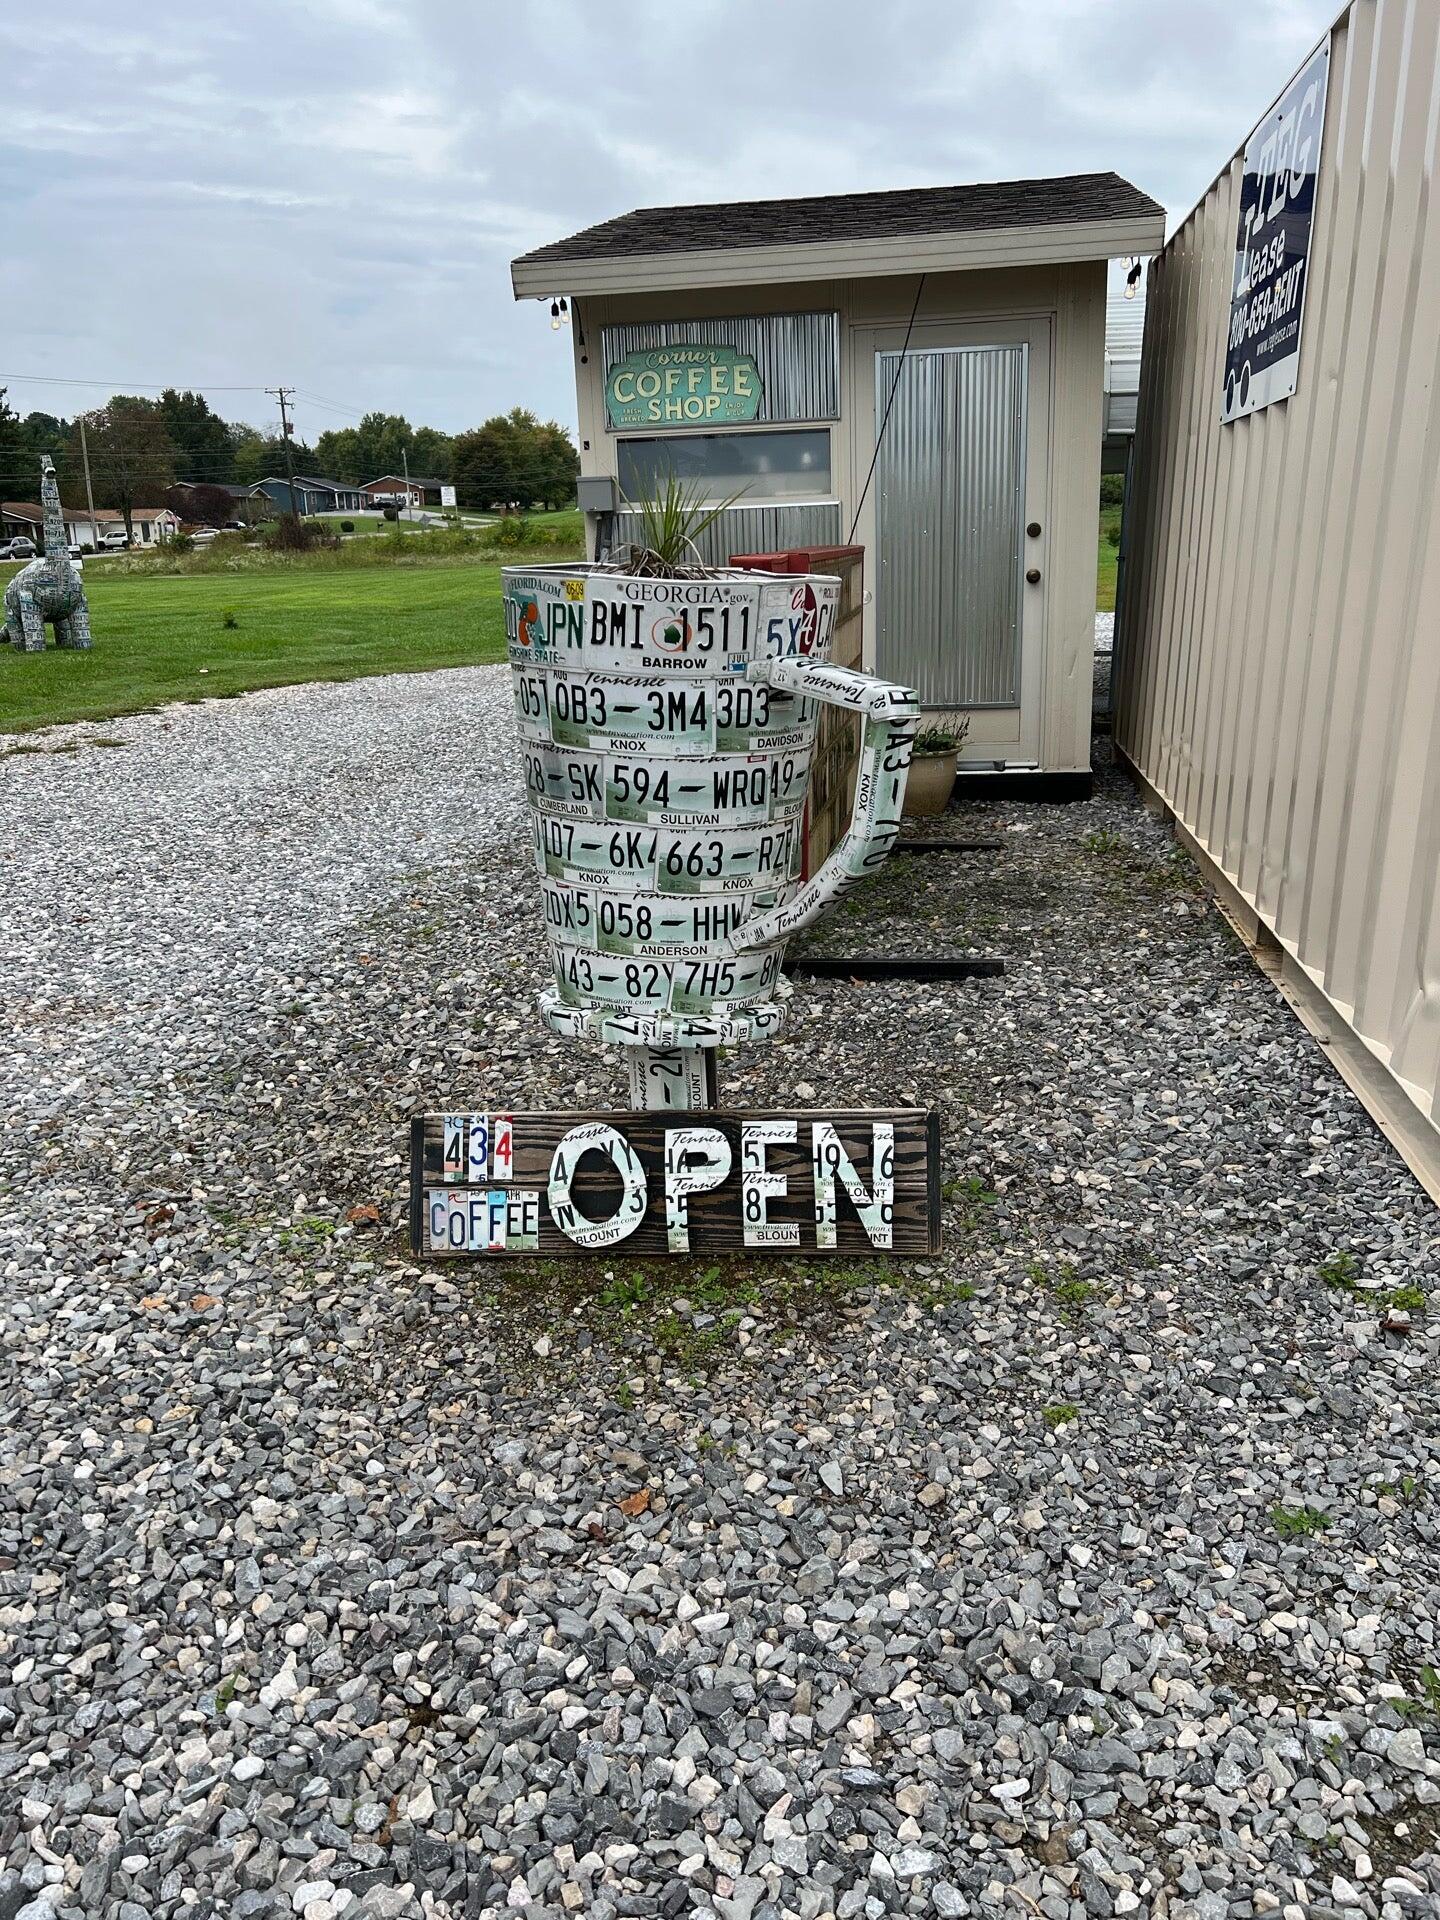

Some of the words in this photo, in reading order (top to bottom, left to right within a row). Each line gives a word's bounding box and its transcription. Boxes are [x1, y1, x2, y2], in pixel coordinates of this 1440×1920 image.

[1252, 80, 1318, 236] TEG
[1237, 203, 1286, 299] Lease
[645, 351, 719, 369] Corner
[613, 363, 753, 403] COFFEE
[648, 395, 721, 421] SHOP
[539, 602, 584, 649] JPN
[591, 598, 645, 649] BMI
[679, 606, 749, 652] 1511
[642, 656, 708, 669] BARROW
[802, 674, 867, 705] Tennessee
[647, 691, 707, 731] 3M4
[610, 739, 647, 752] KNOX
[757, 733, 804, 748] DAVIDSON
[568, 763, 603, 802] SK
[613, 764, 669, 809] 594
[713, 768, 766, 809] WRQ
[858, 773, 871, 812] KNOX
[540, 799, 588, 816] CUMBERLAND
[660, 814, 720, 826] SULLIVAN
[666, 840, 724, 877] 663
[579, 872, 609, 885] KNOX
[722, 878, 754, 890] KNOX
[600, 901, 652, 941] 058
[774, 888, 821, 934] Tennessee
[640, 945, 708, 956] ANDERSON
[685, 961, 736, 997] 7H5
[445, 1126, 512, 1168] 434
[547, 1120, 895, 1252] OPEN
[431, 1200, 538, 1247] COFFEE
[575, 1228, 621, 1245] BLOUNT
